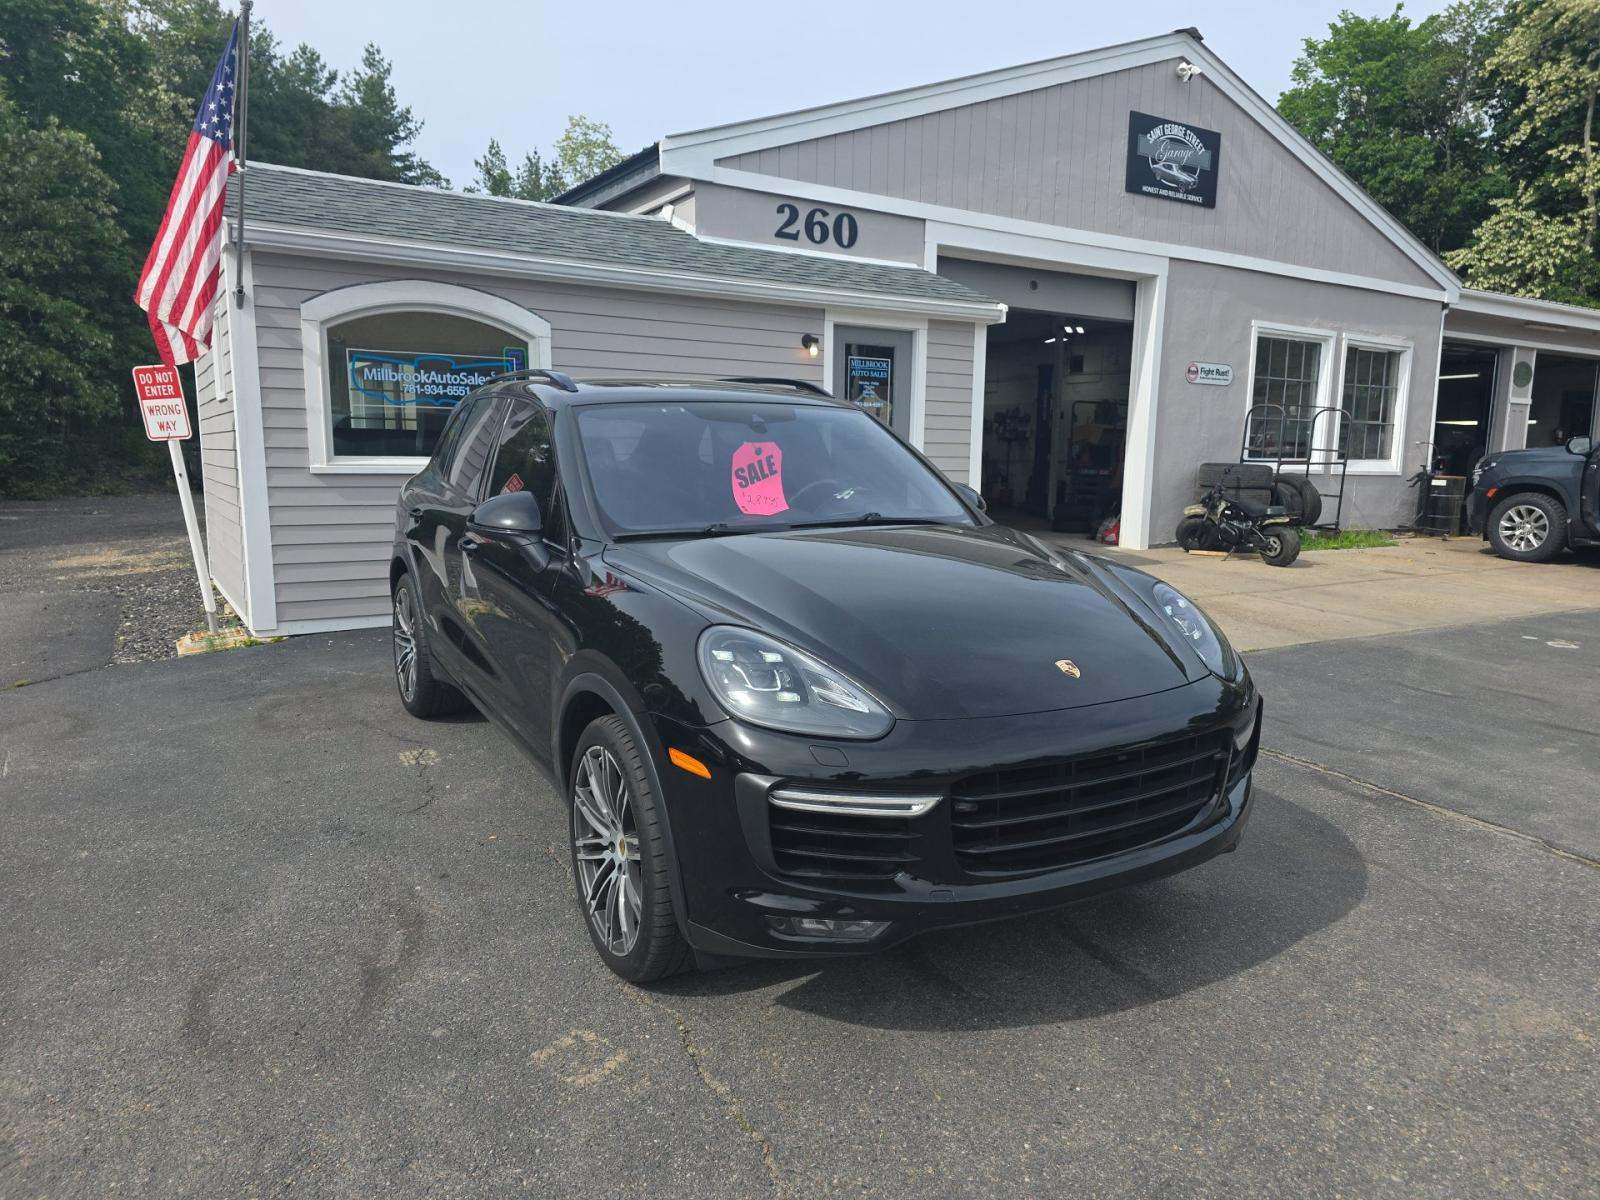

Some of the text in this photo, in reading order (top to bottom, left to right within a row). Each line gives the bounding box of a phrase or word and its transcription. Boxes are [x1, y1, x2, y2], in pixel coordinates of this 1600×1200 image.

[1146, 123, 1206, 155] SAINT GEORGE STREET
[1155, 139, 1194, 166] Garage
[1142, 185, 1159, 194] HONEST
[774, 203, 858, 249] 260
[851, 360, 888, 369] MILLBROOK
[139, 371, 174, 385] DO NOT
[851, 369, 888, 378] AUTO SALES
[144, 384, 175, 397] ENTER
[402, 383, 471, 396] 781-934-6551
[147, 403, 181, 416] WRONG
[157, 420, 177, 432] WAY
[735, 454, 778, 489] SALE
